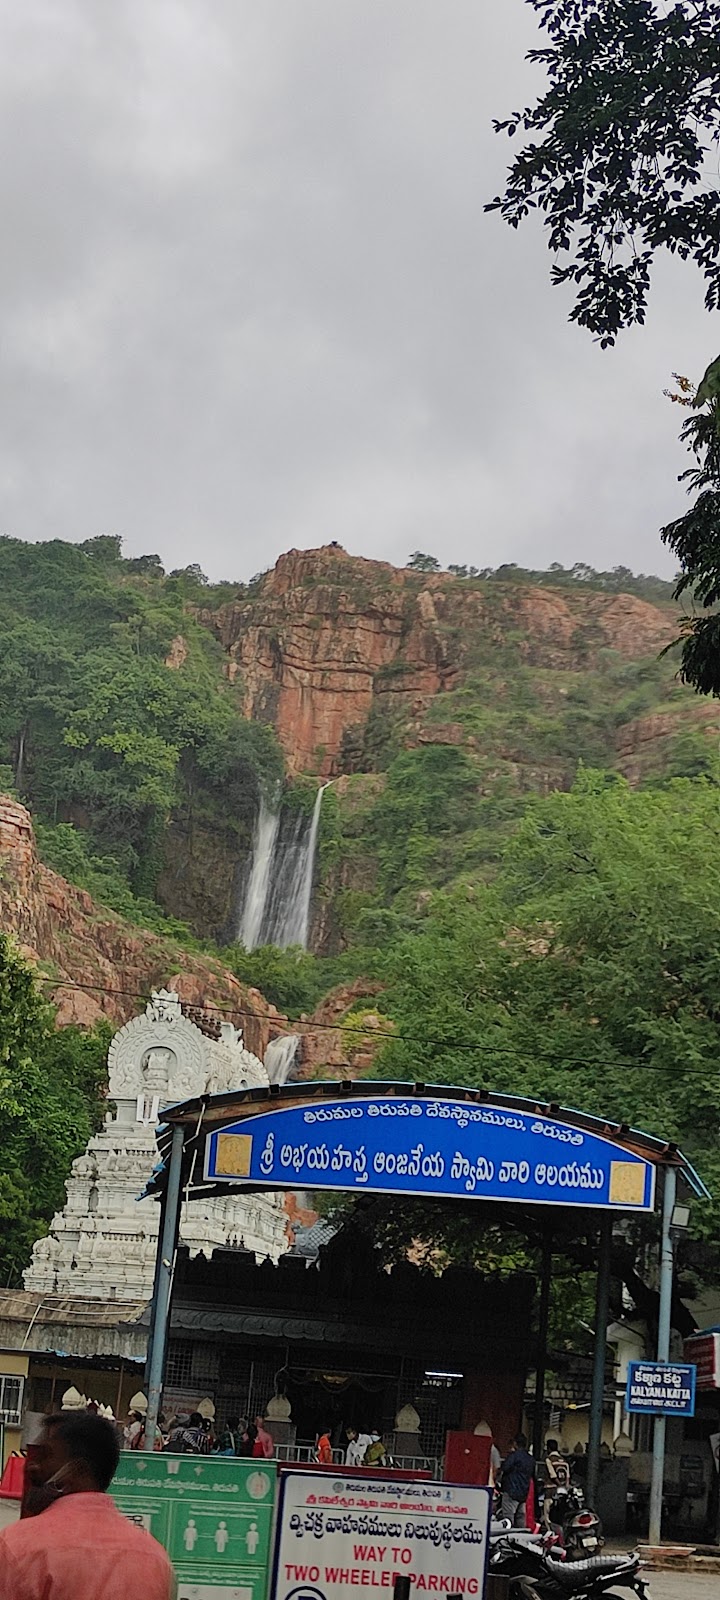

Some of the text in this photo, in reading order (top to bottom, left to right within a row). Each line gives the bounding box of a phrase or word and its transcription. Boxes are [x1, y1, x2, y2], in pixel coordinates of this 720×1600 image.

[303, 1106, 364, 1124] తిరుమల
[367, 1103, 423, 1117] తిరుపతి
[530, 1121, 584, 1146] తిరుపతి
[260, 1132, 604, 1191] శ్రీ అభయహస్త ఆంజనేయ స్వామి వారి ఆలయము
[663, 1372, 682, 1388] కట్ట
[630, 1386, 691, 1400] KALYANA KATTA
[289, 1511, 325, 1539] ద్విచక్ర
[325, 1514, 402, 1538] వాహనములు
[353, 1545, 412, 1564] WAY TO
[284, 1564, 320, 1583] TWO
